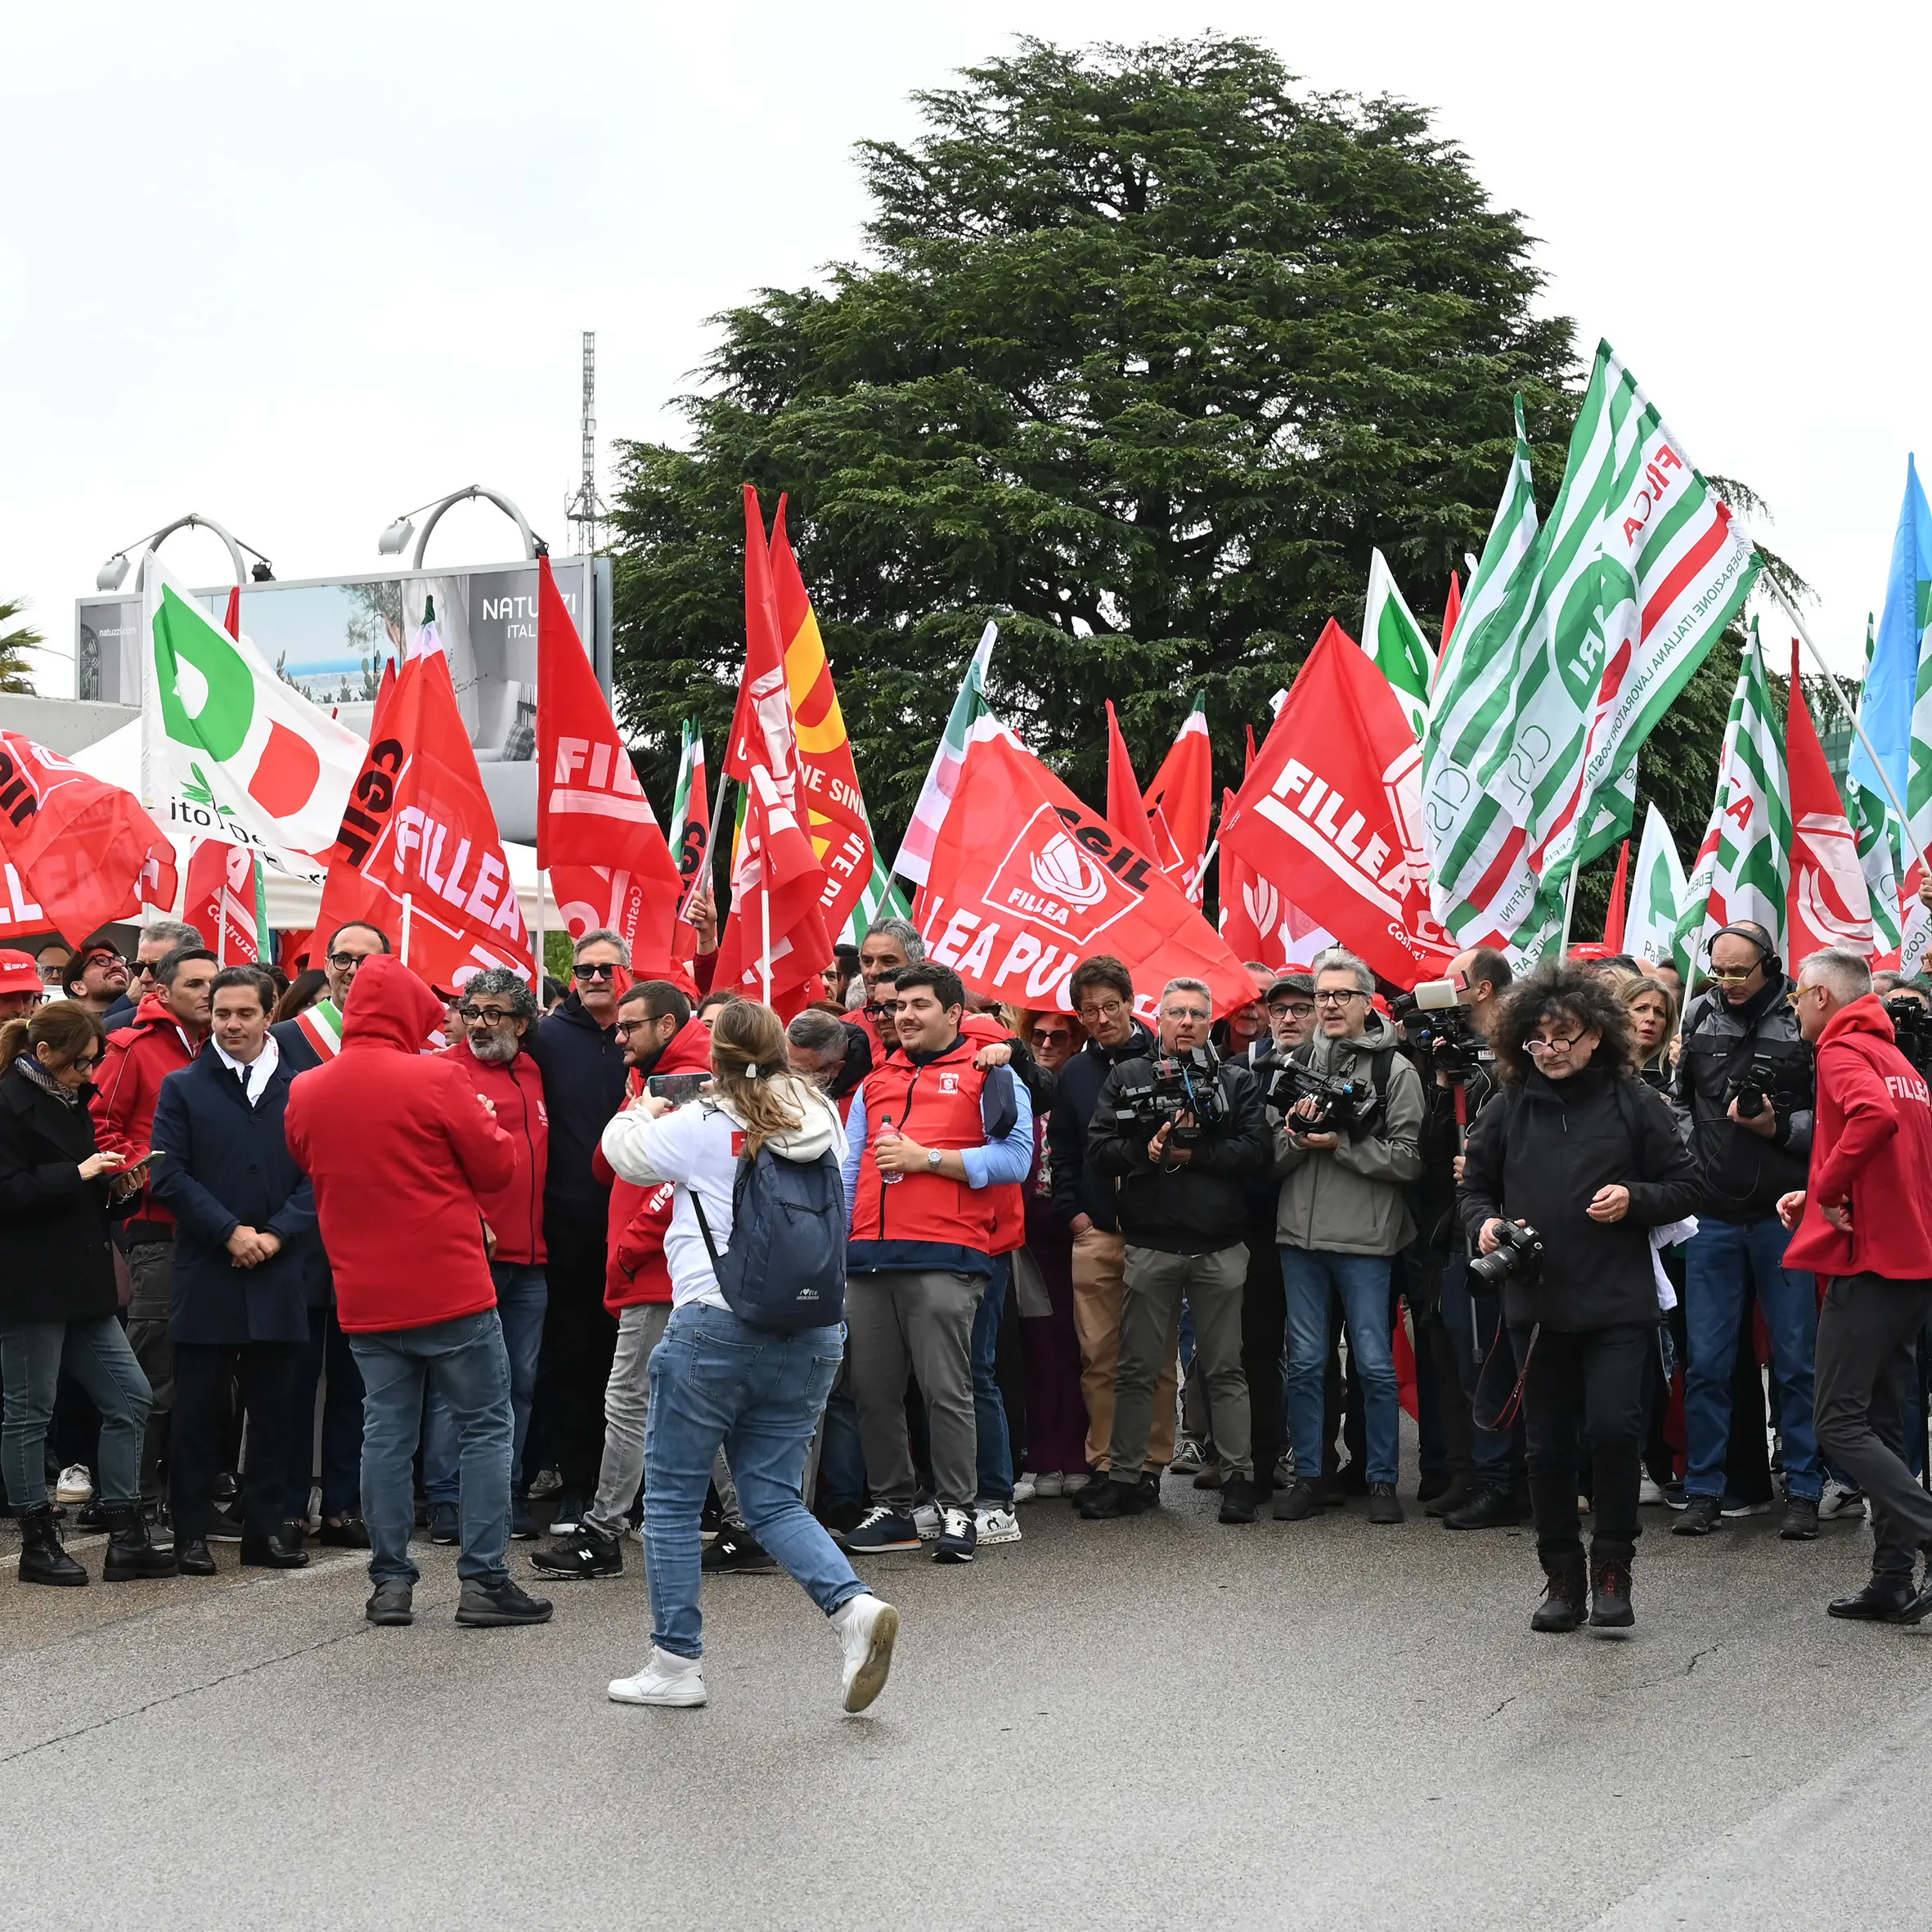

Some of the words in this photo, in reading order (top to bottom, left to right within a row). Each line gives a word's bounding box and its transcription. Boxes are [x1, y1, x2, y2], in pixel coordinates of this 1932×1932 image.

[483, 593, 576, 620] NATUZI
[99, 627, 137, 637] natuzzi.com
[507, 624, 537, 639] ITAL
[554, 736, 644, 797] FIL
[799, 762, 826, 793] NE
[171, 796, 211, 826] ito
[335, 739, 403, 868] CGIL
[1271, 757, 1412, 902] FILLEA
[393, 805, 520, 941] FILLEA
[1007, 887, 1070, 925] FILLEA
[922, 896, 1001, 980] LEA
